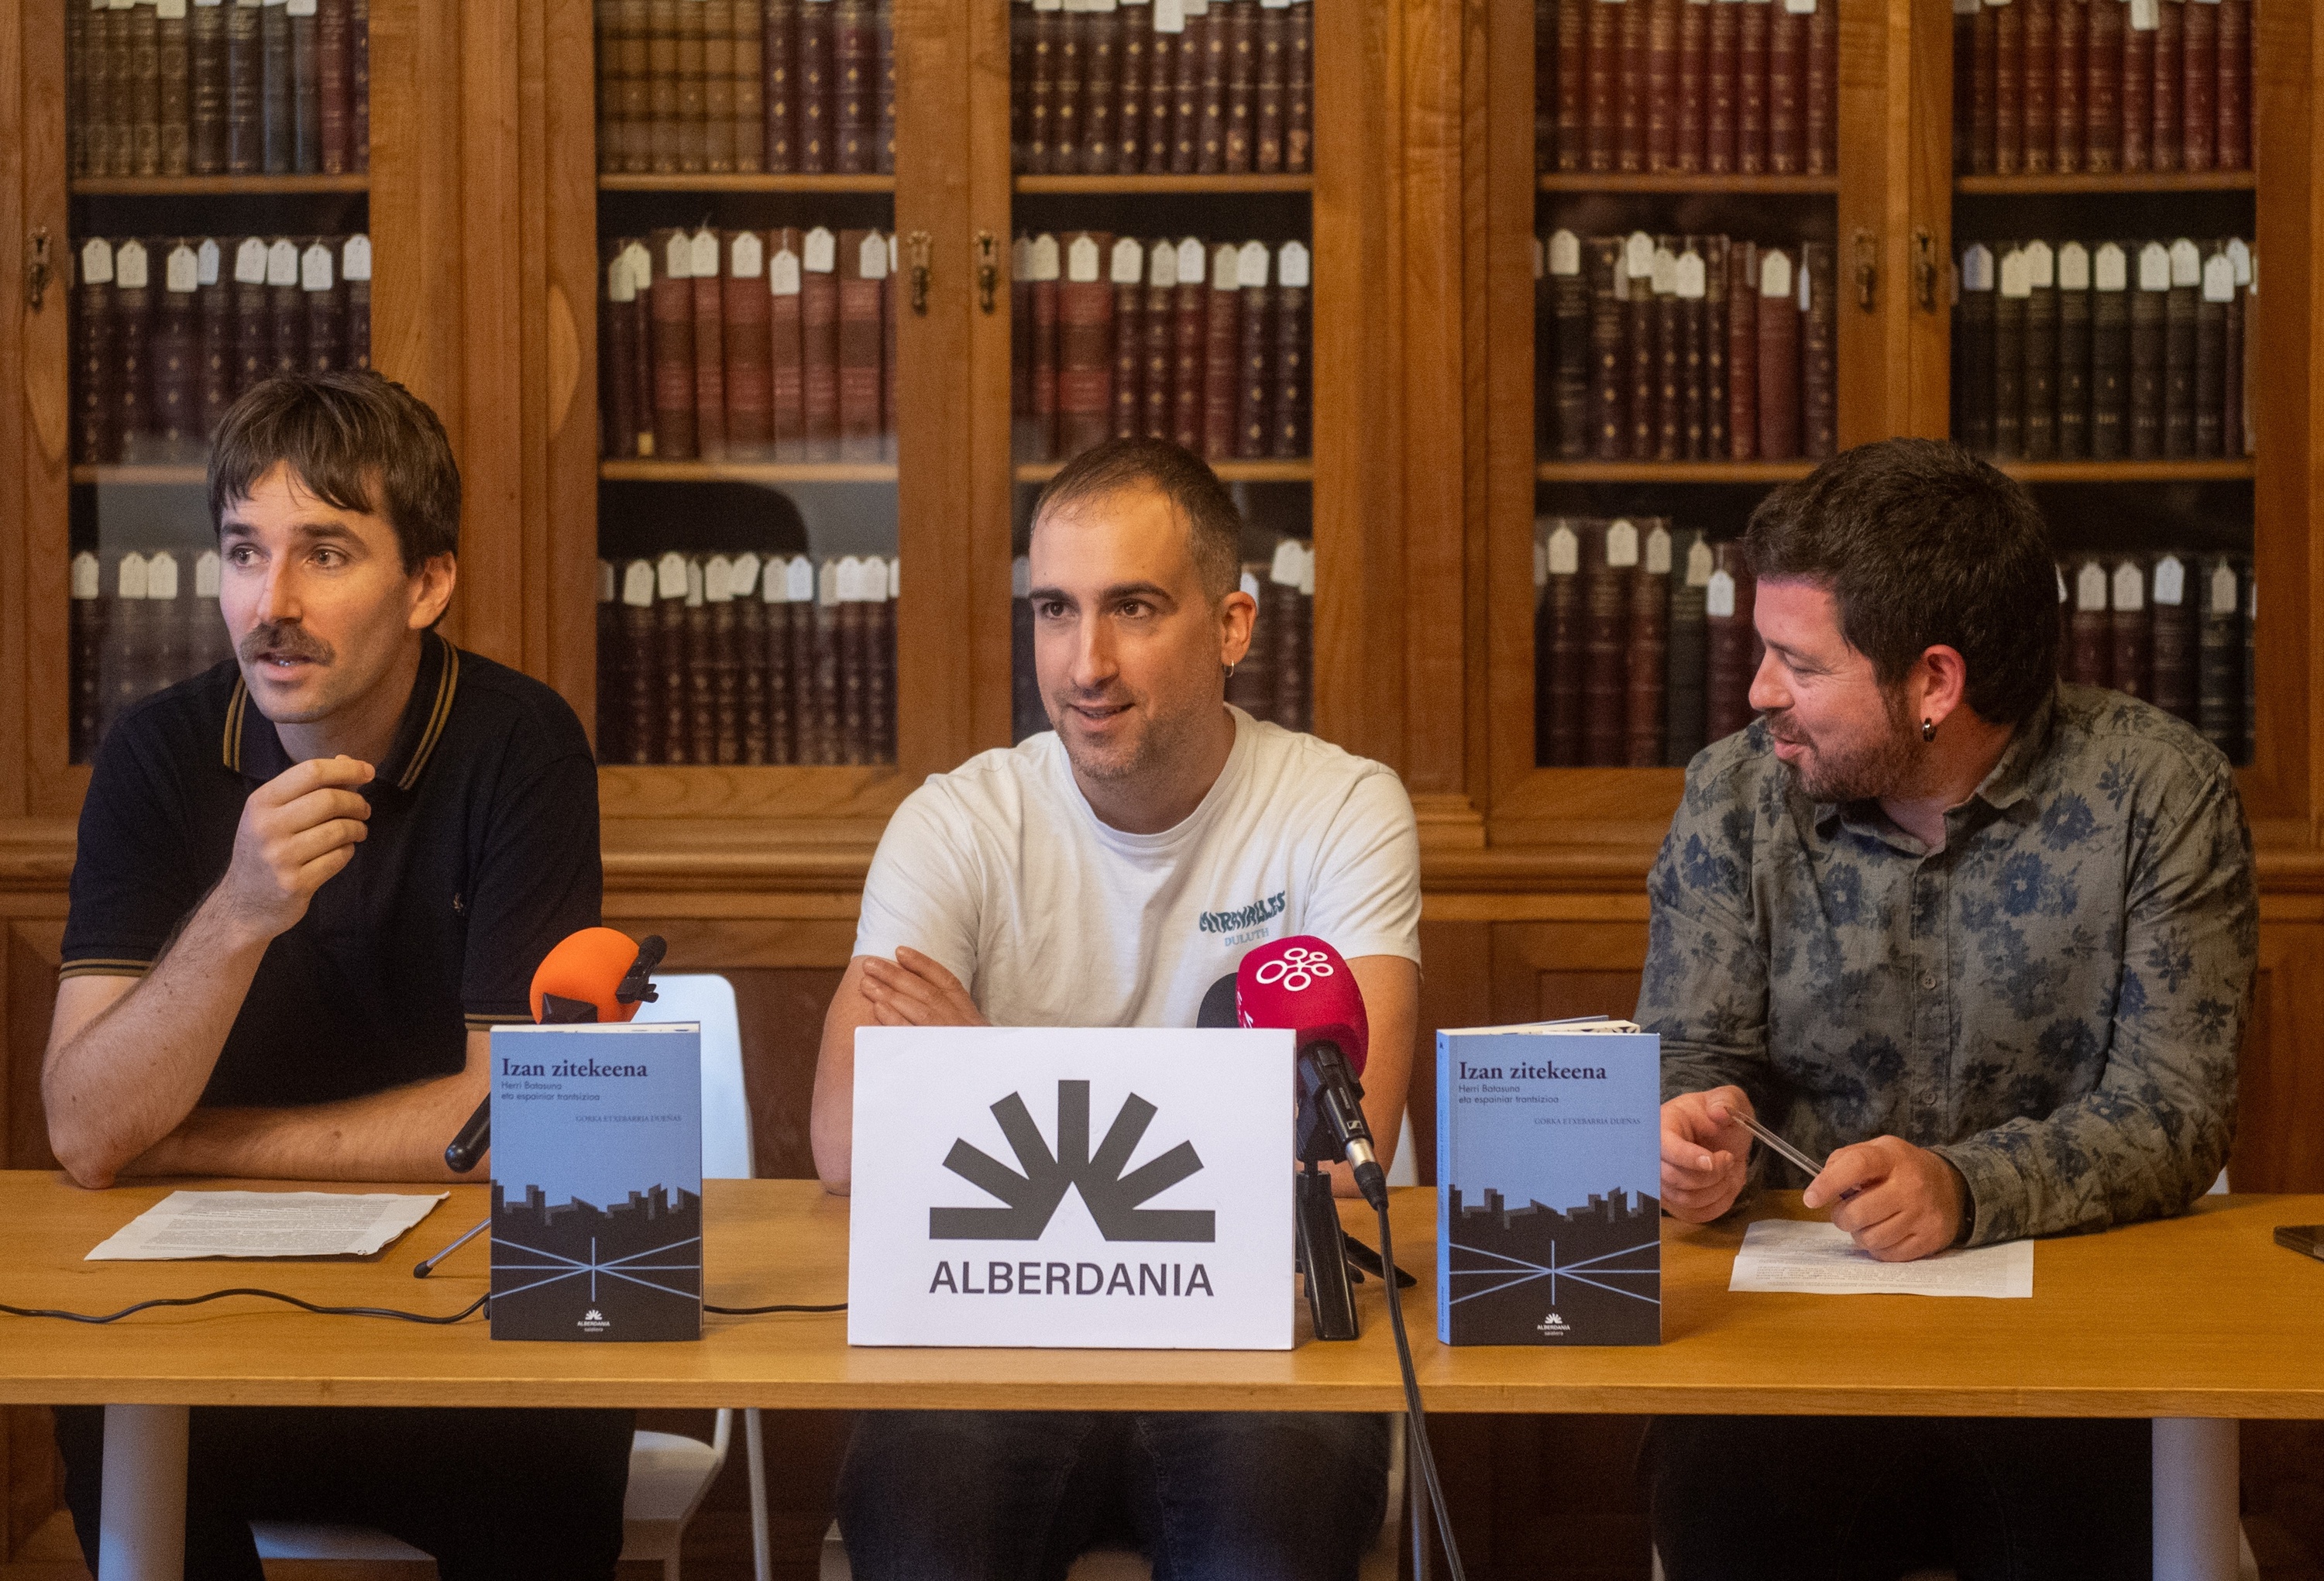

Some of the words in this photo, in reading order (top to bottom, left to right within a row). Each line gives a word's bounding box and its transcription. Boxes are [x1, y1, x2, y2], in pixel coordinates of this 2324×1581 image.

[1225, 928, 1270, 947] DULUTH
[502, 1058, 545, 1077] Izan
[552, 1058, 648, 1077] zitekeena
[1459, 1061, 1504, 1080] Izan
[1511, 1060, 1607, 1081] zitekeena
[501, 1081, 521, 1091] Herri
[524, 1081, 562, 1091] Batasuna
[1459, 1084, 1480, 1094] Herri
[1482, 1084, 1521, 1094] Batasuna
[517, 1093, 555, 1102] espainiar
[557, 1093, 600, 1102] trantsizioa
[1459, 1096, 1473, 1105] eta
[1474, 1095, 1514, 1106] espainiar
[1515, 1095, 1559, 1104] trantsizioa
[929, 1260, 1215, 1297] ALBERDANIA
